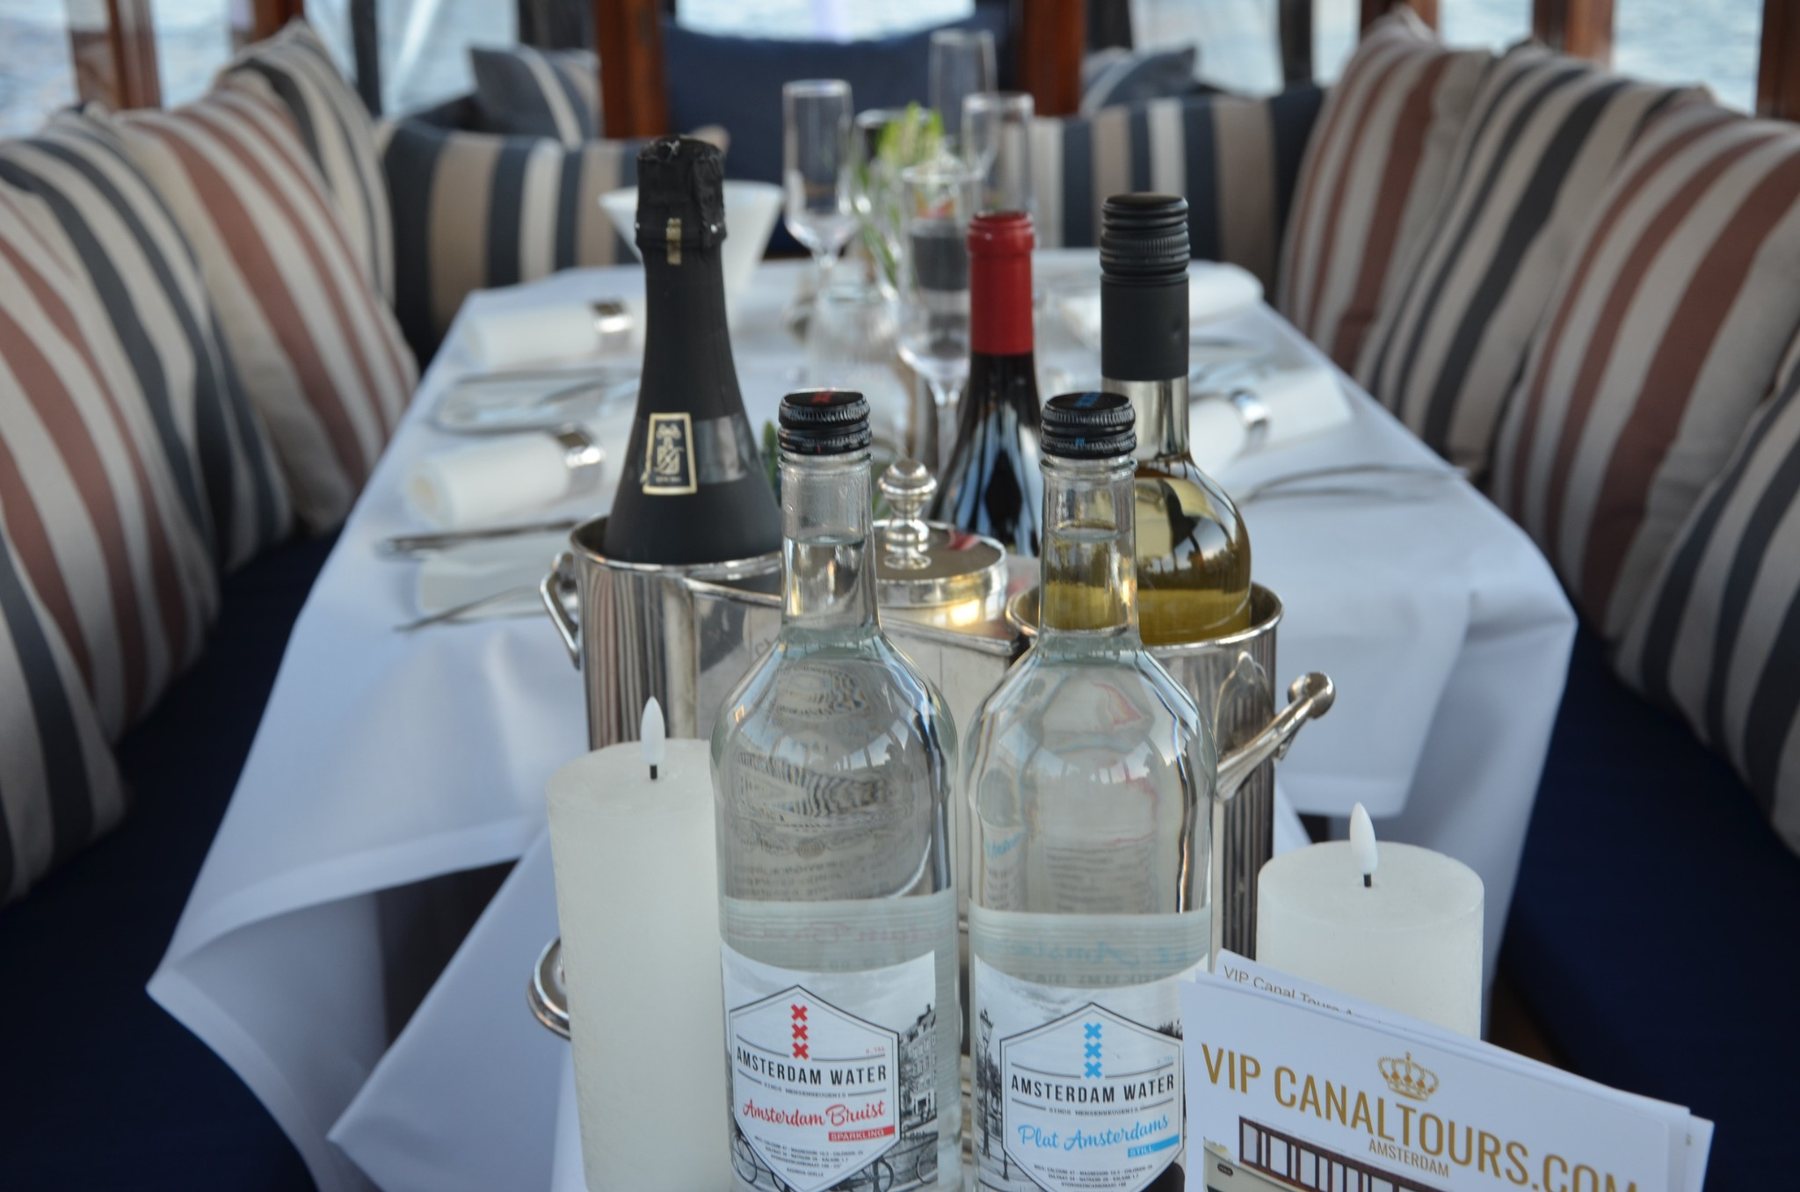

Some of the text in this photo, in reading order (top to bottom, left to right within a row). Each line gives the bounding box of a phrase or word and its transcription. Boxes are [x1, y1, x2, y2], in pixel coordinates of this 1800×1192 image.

[1224, 964, 1249, 984] VIP
[1253, 976, 1296, 999] Canal
[736, 1046, 887, 1086] AMSTERDAM WATER
[1201, 1042, 1261, 1094] VIP
[1011, 1073, 1175, 1104] AMSTERDAM WATER
[743, 1098, 885, 1128] Amsterdam Bruist
[829, 1127, 885, 1142] SPARKLING
[1017, 1114, 1169, 1151] Plat Amsterdams
[1368, 1138, 1449, 1179] AMSTERDAM
